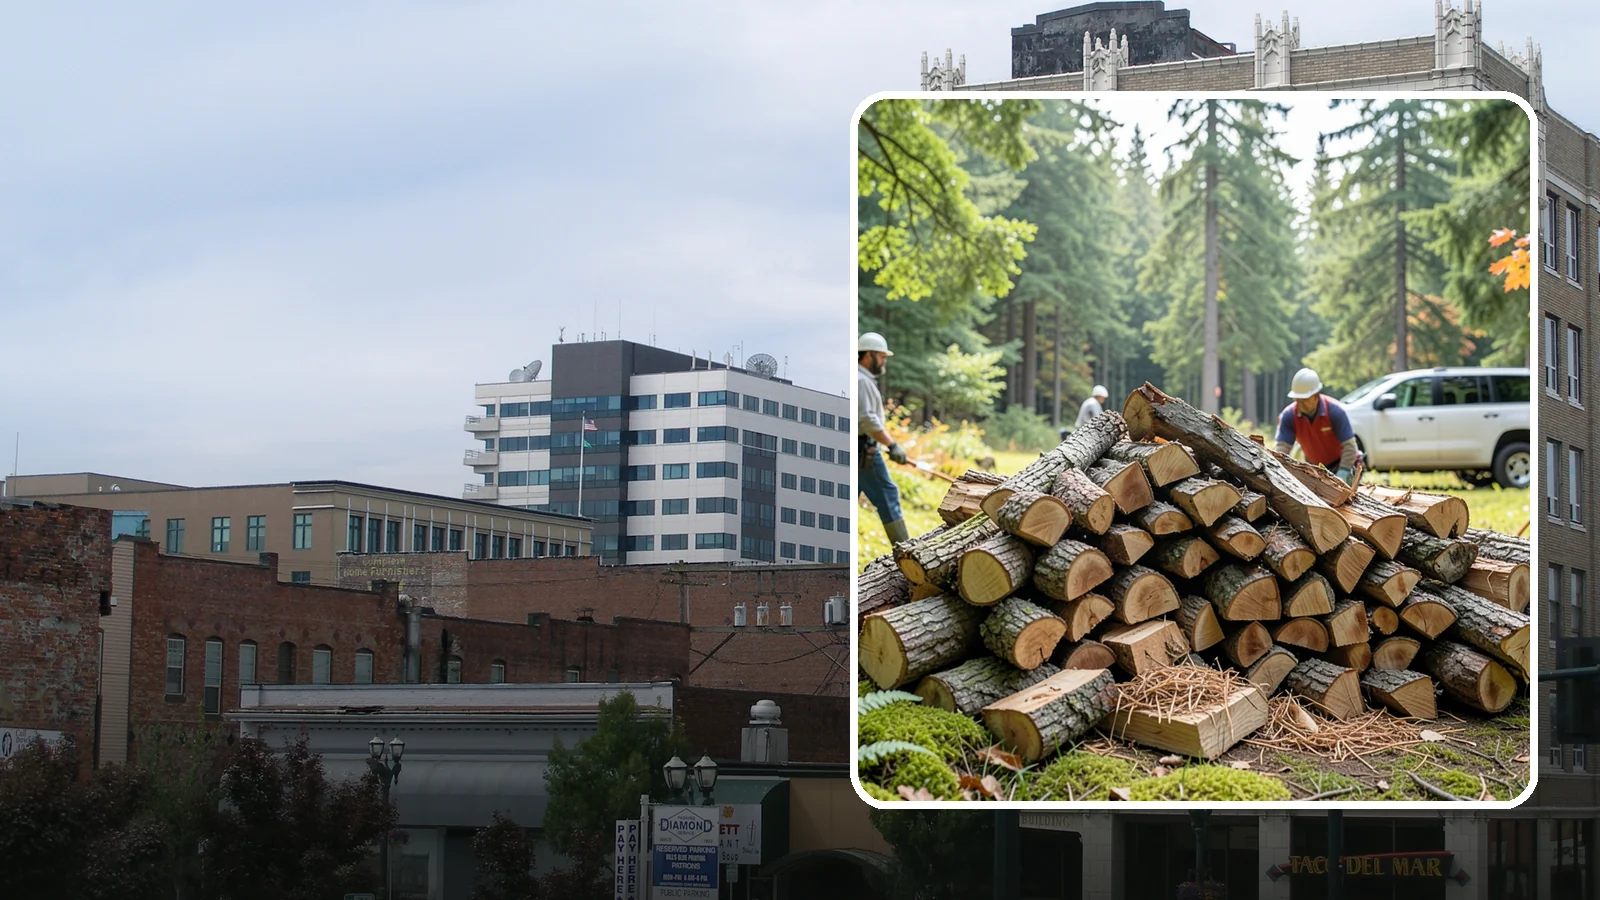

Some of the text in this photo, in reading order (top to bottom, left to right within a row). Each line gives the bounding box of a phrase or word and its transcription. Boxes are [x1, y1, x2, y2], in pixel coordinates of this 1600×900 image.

[660, 818, 713, 833] DIAMOND
[1021, 814, 1069, 827] BUILDING
[719, 823, 740, 836] ETT
[656, 845, 716, 854] RESERVED PARKING
[616, 825, 625, 894] PAY HERE
[627, 824, 637, 893] PAY HERE
[721, 851, 739, 862] Soup
[671, 862, 701, 870] PATRONS
[1289, 855, 1443, 877] TAC DEL MAR
[660, 888, 710, 898] PUBLIC PARKING
